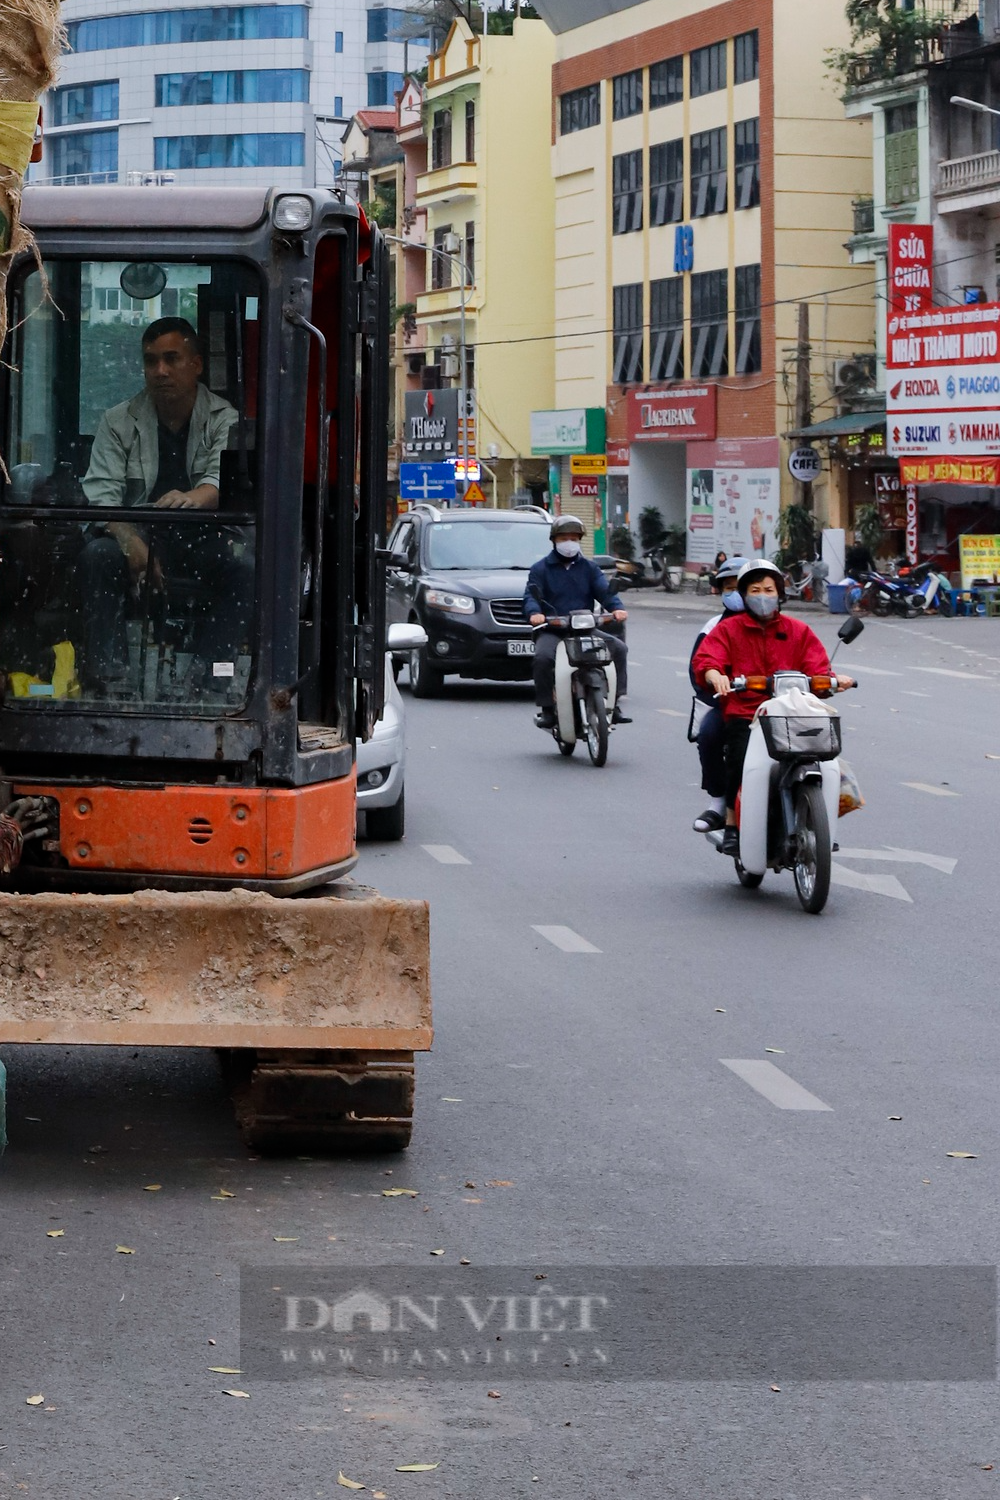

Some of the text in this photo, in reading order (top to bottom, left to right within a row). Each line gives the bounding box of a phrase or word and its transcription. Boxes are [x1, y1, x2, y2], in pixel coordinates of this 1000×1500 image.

[898, 232, 926, 259] SỬA
[894, 264, 930, 288] CHỮA
[892, 330, 998, 366] NHẬT THÀNH MOTO
[905, 376, 1000, 397] HONDA PIAGGIO
[651, 408, 696, 427] AGRIBANK
[905, 423, 1000, 442] SUZUKI YAMAHA
[573, 484, 598, 494] ATM
[906, 484, 917, 565] HONDA
